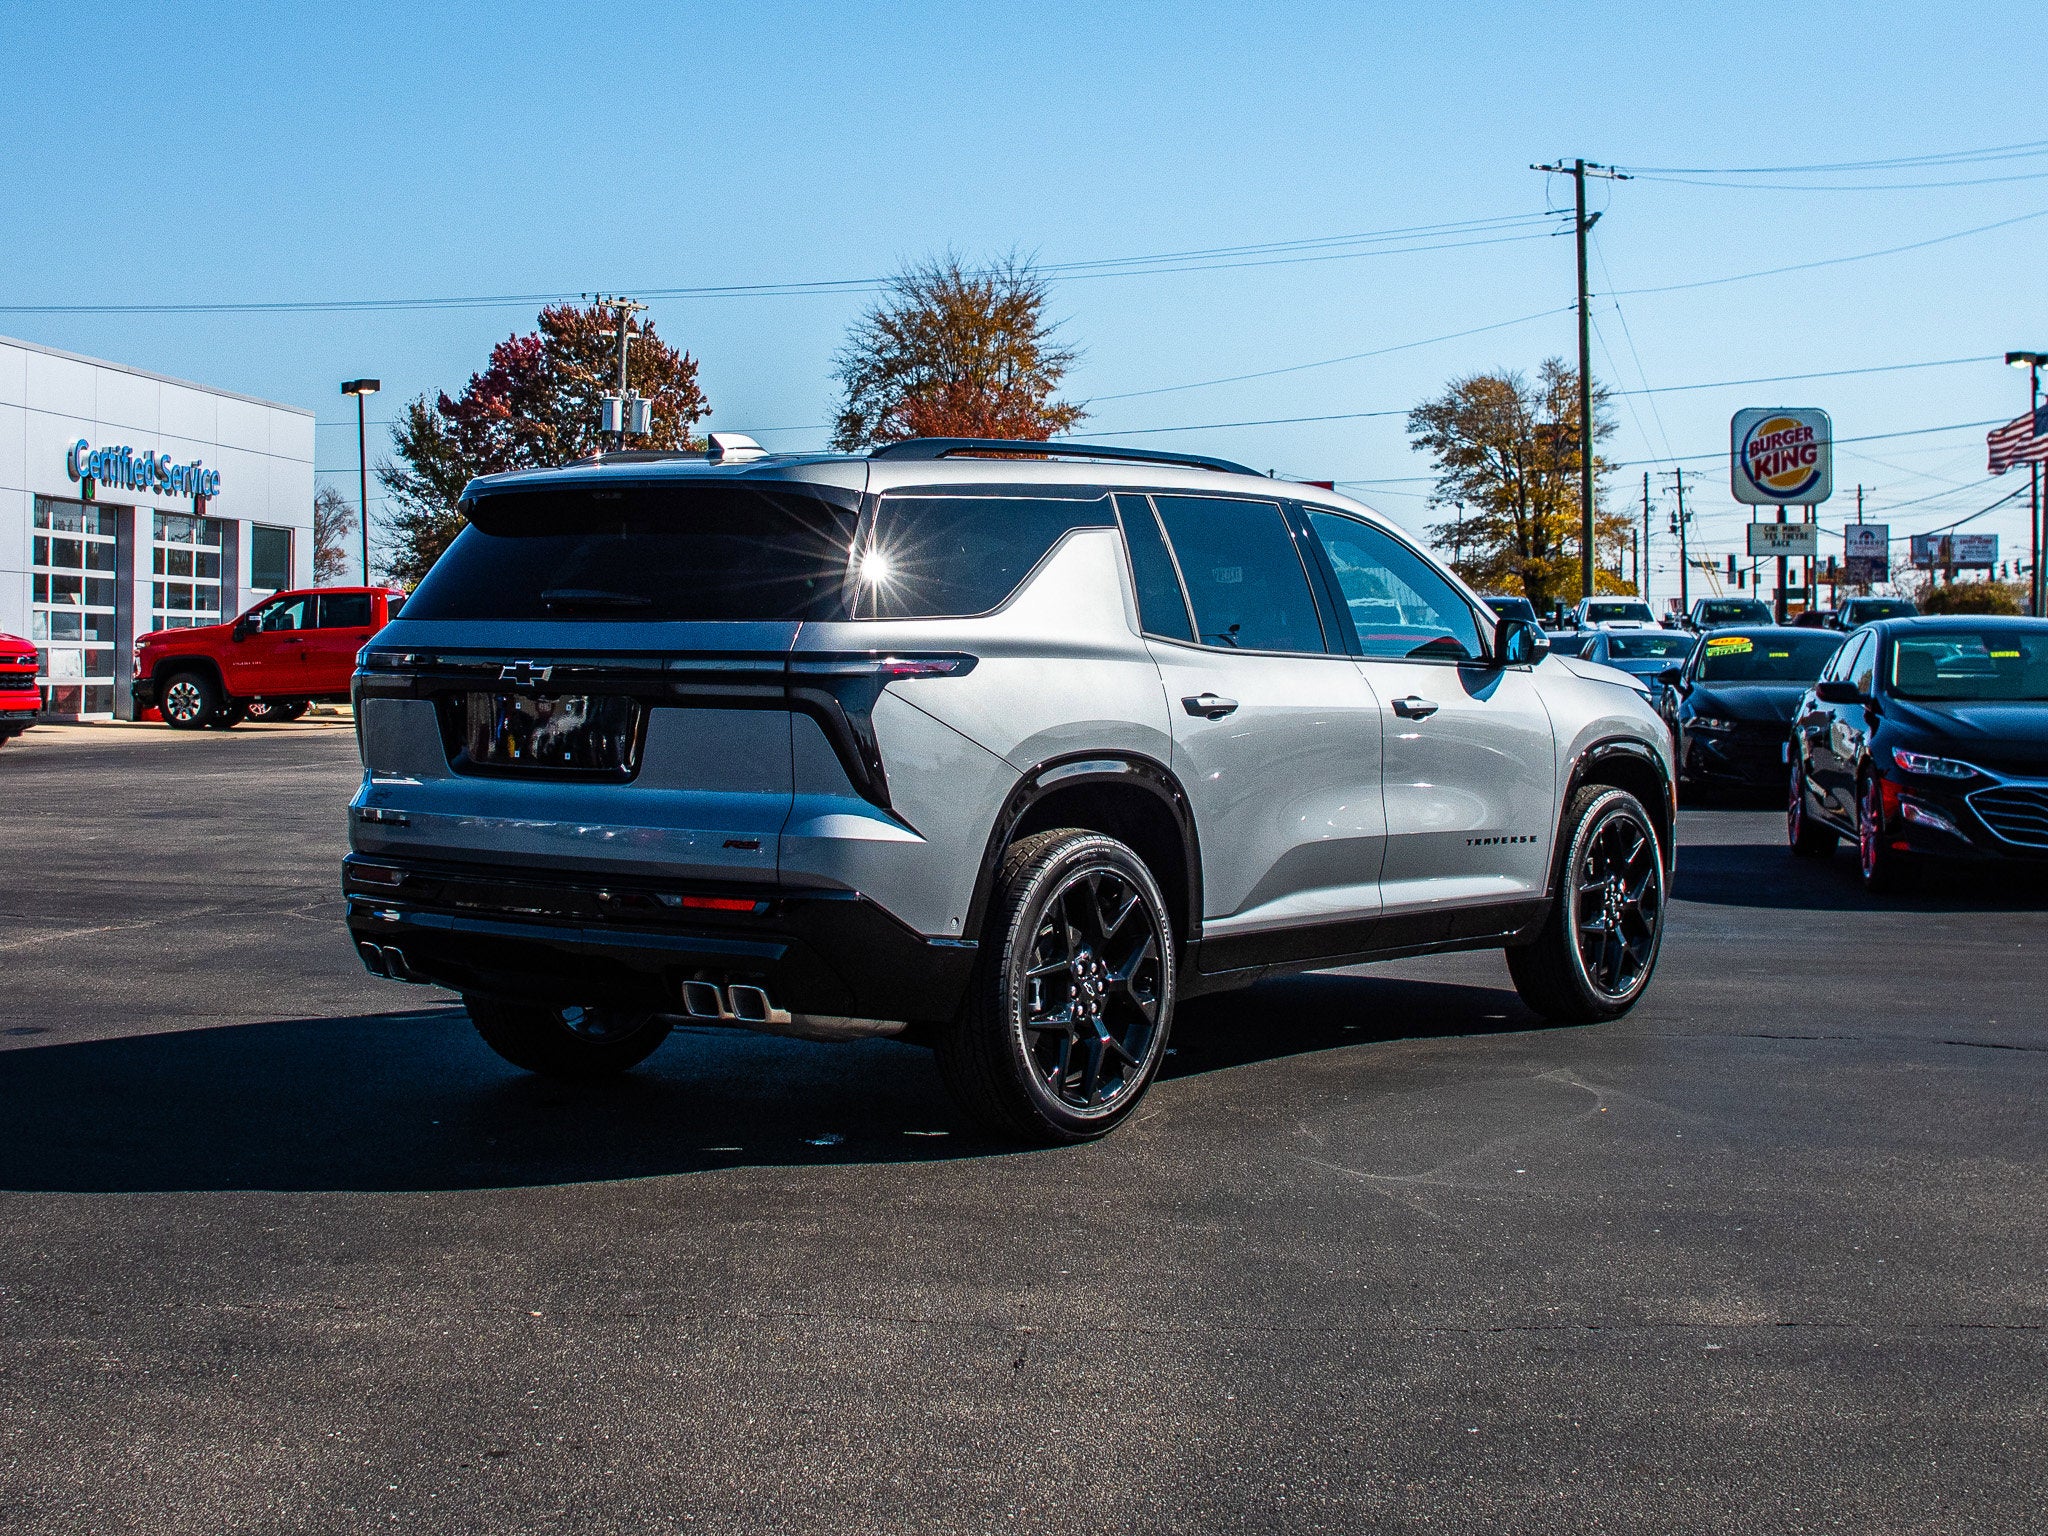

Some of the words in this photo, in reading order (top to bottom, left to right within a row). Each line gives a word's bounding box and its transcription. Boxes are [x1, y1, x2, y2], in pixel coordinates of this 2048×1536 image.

[1749, 426, 1814, 459] BURGER
[75, 438, 156, 487] Certified
[160, 453, 221, 496] Service
[1754, 443, 1818, 481] KING
[722, 840, 760, 849] RS
[1466, 835, 1537, 846] TRAVERSE
